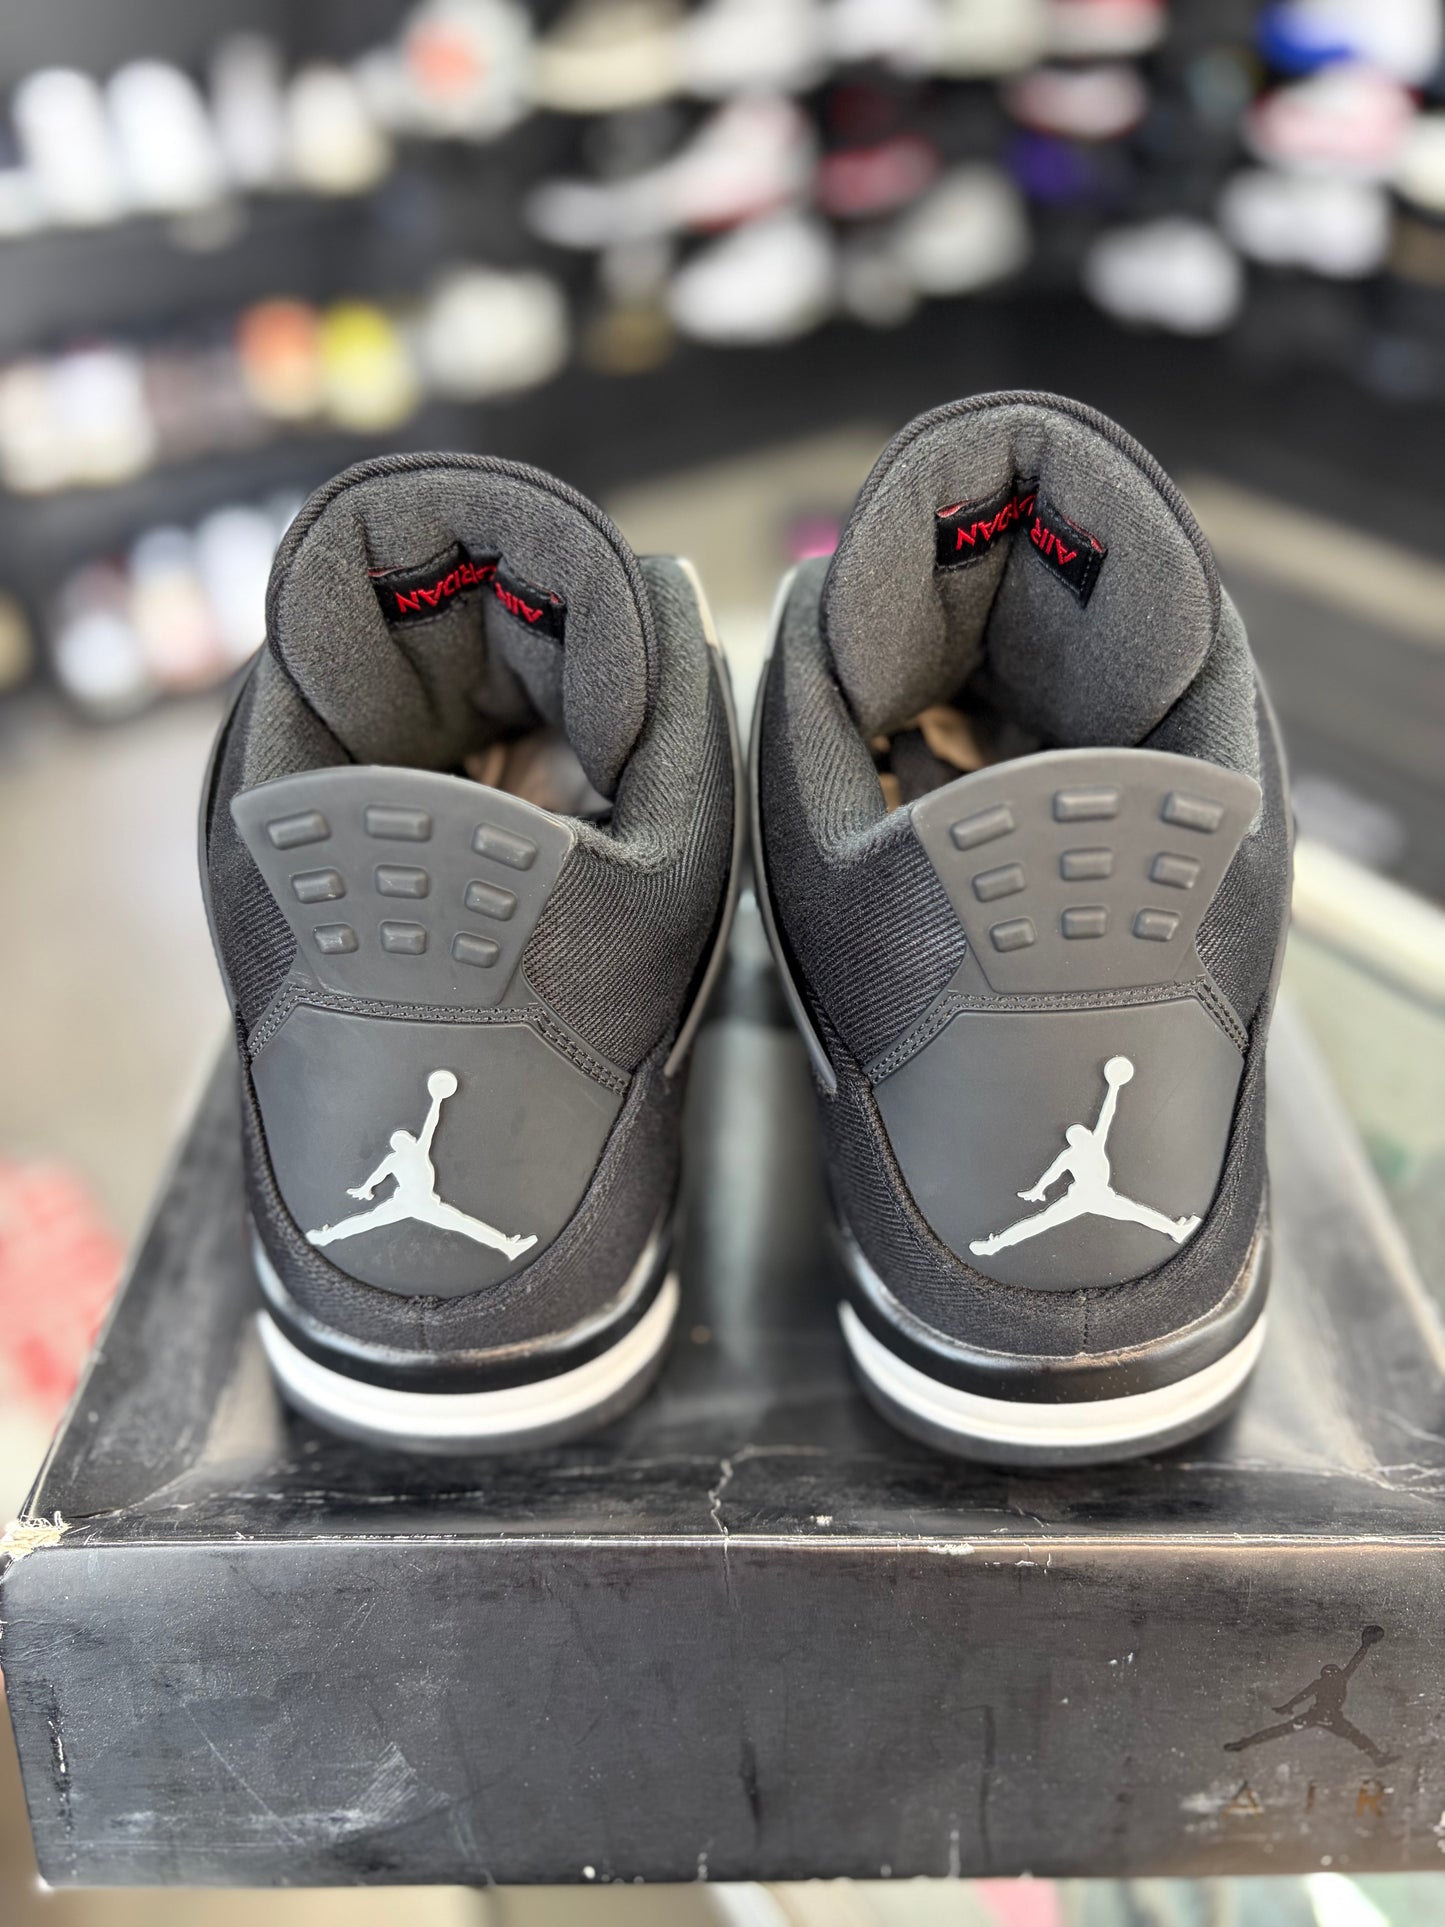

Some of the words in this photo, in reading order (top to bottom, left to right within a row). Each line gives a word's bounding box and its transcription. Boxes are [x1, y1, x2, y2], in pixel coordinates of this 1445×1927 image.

[956, 494, 1037, 551] DAN
[1031, 518, 1077, 565] AIR
[395, 562, 497, 613] RDAN
[1222, 1779, 1384, 1819] AIR
